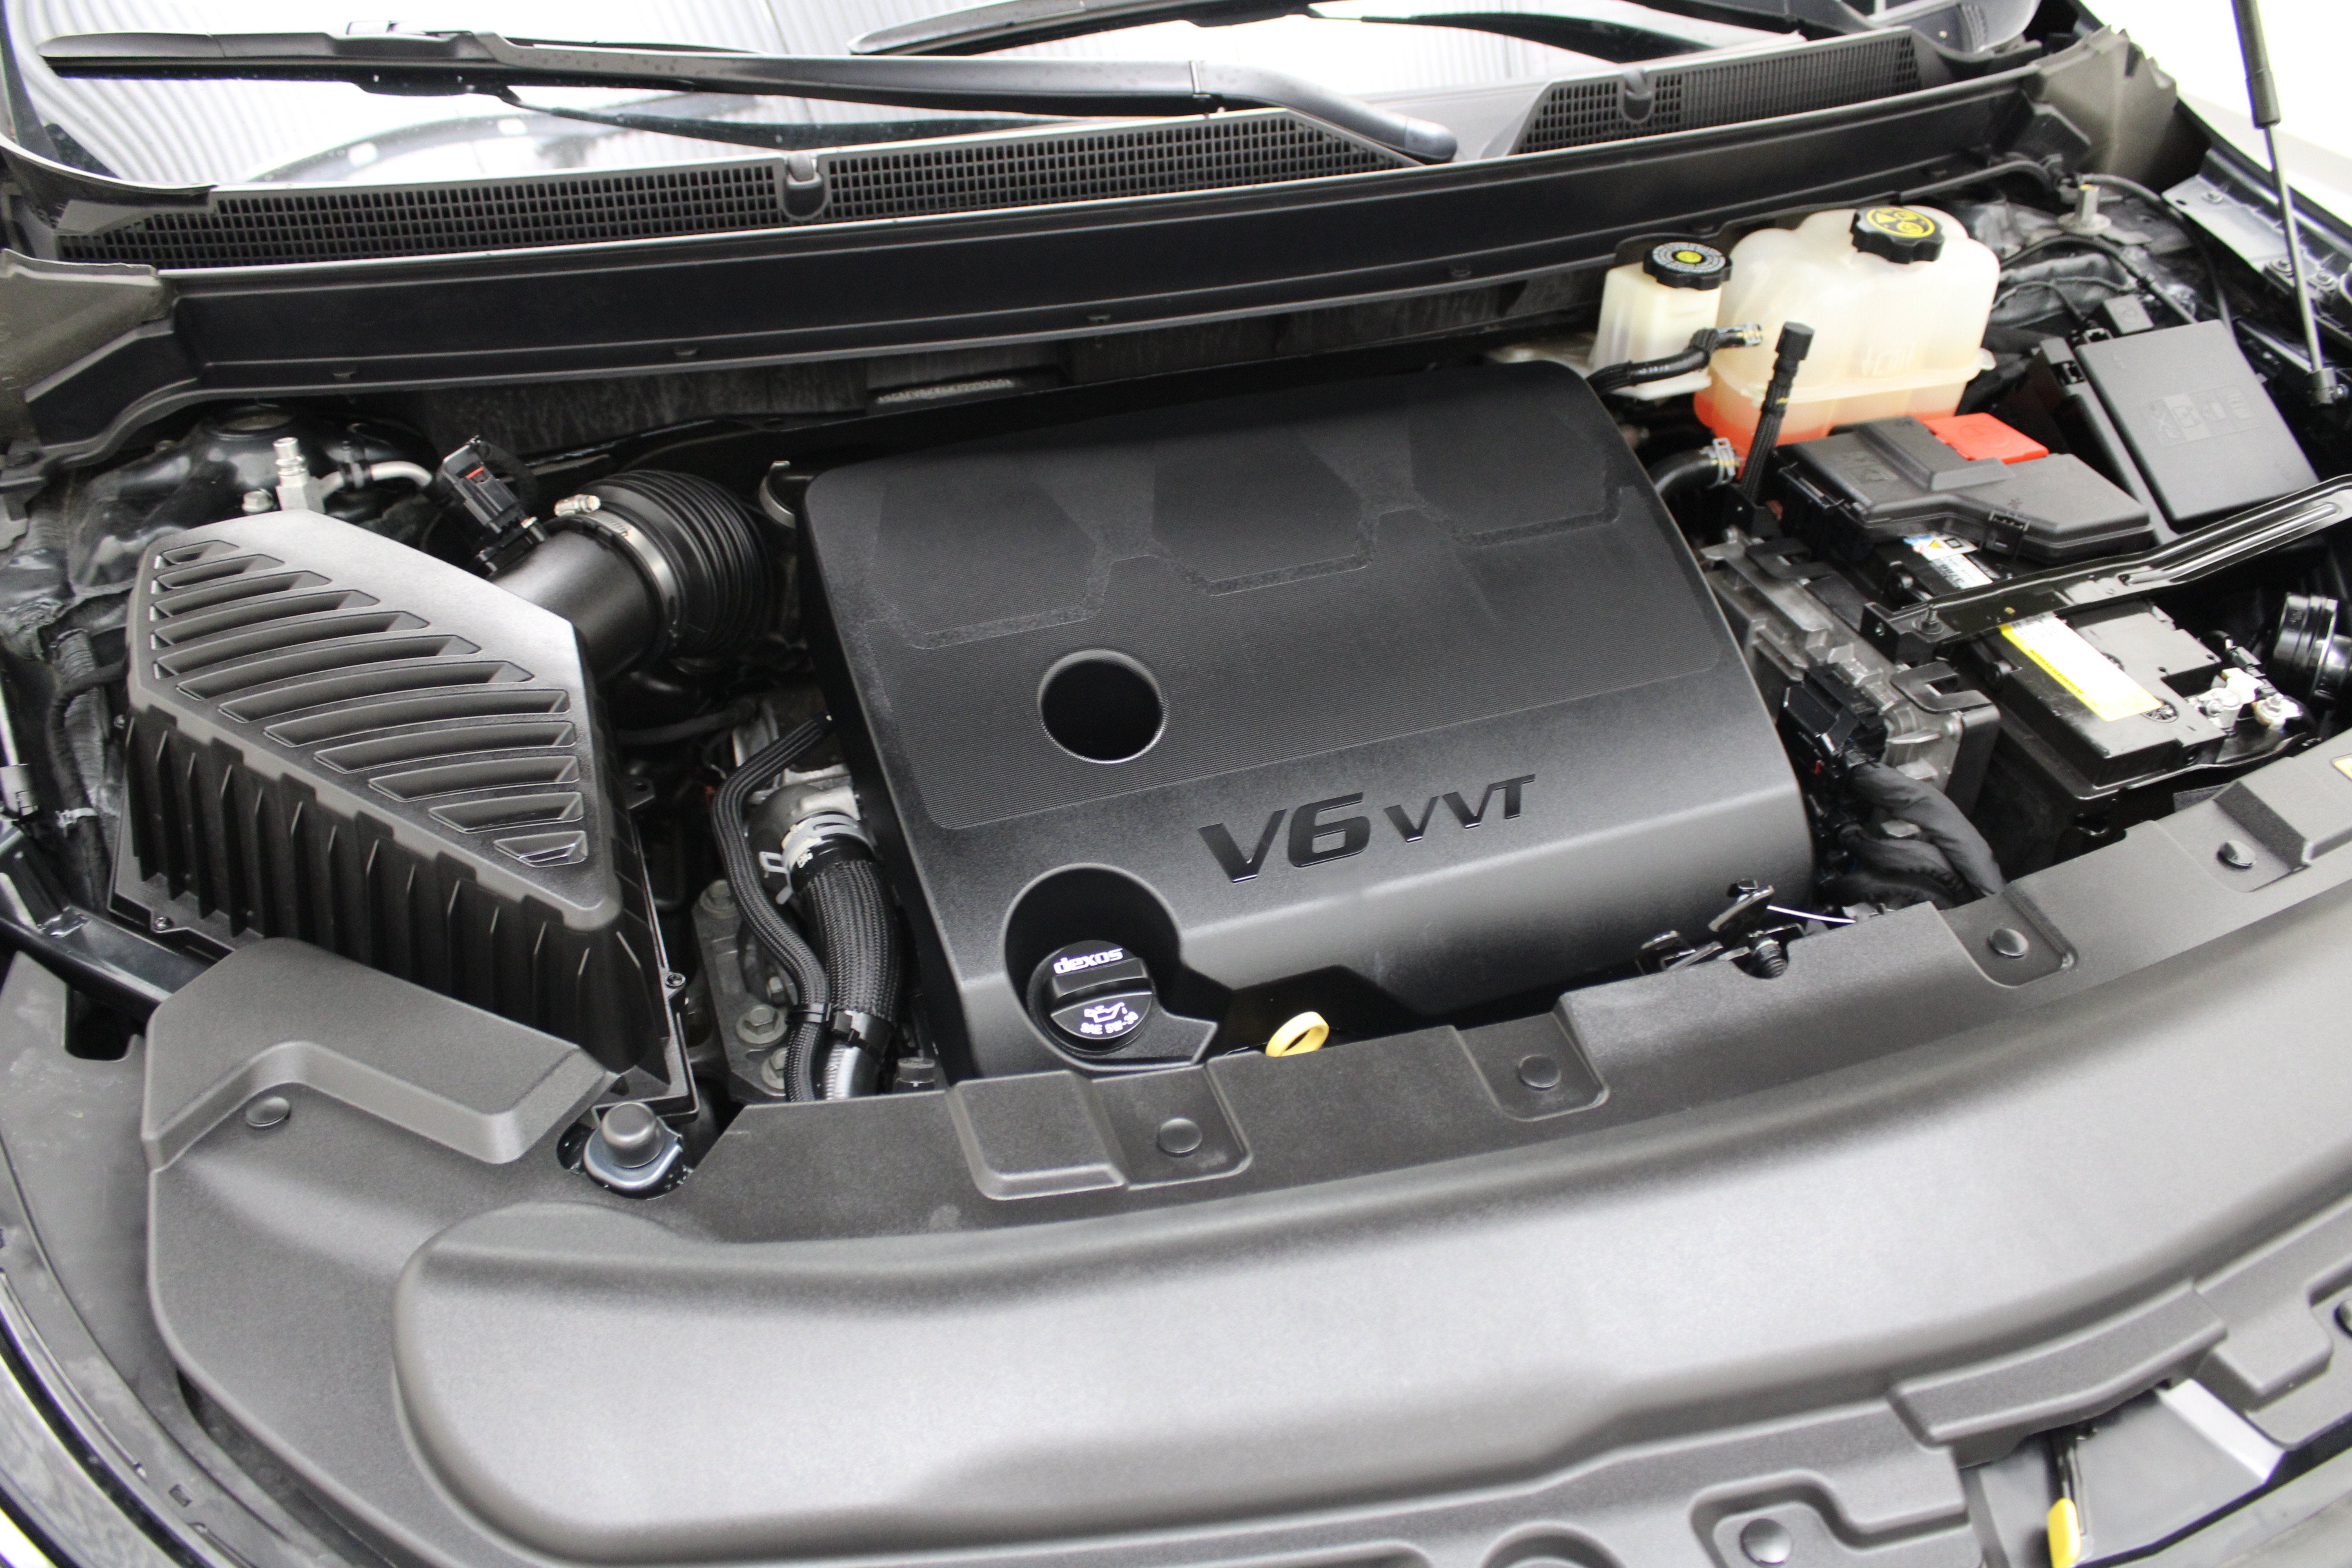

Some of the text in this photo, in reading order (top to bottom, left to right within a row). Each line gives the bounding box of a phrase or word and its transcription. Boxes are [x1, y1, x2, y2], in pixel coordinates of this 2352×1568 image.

[1198, 774, 1536, 883] V6 VVT
[1053, 948, 1123, 974] dexos
[1080, 1011, 1139, 1035] SAE 5W-30
